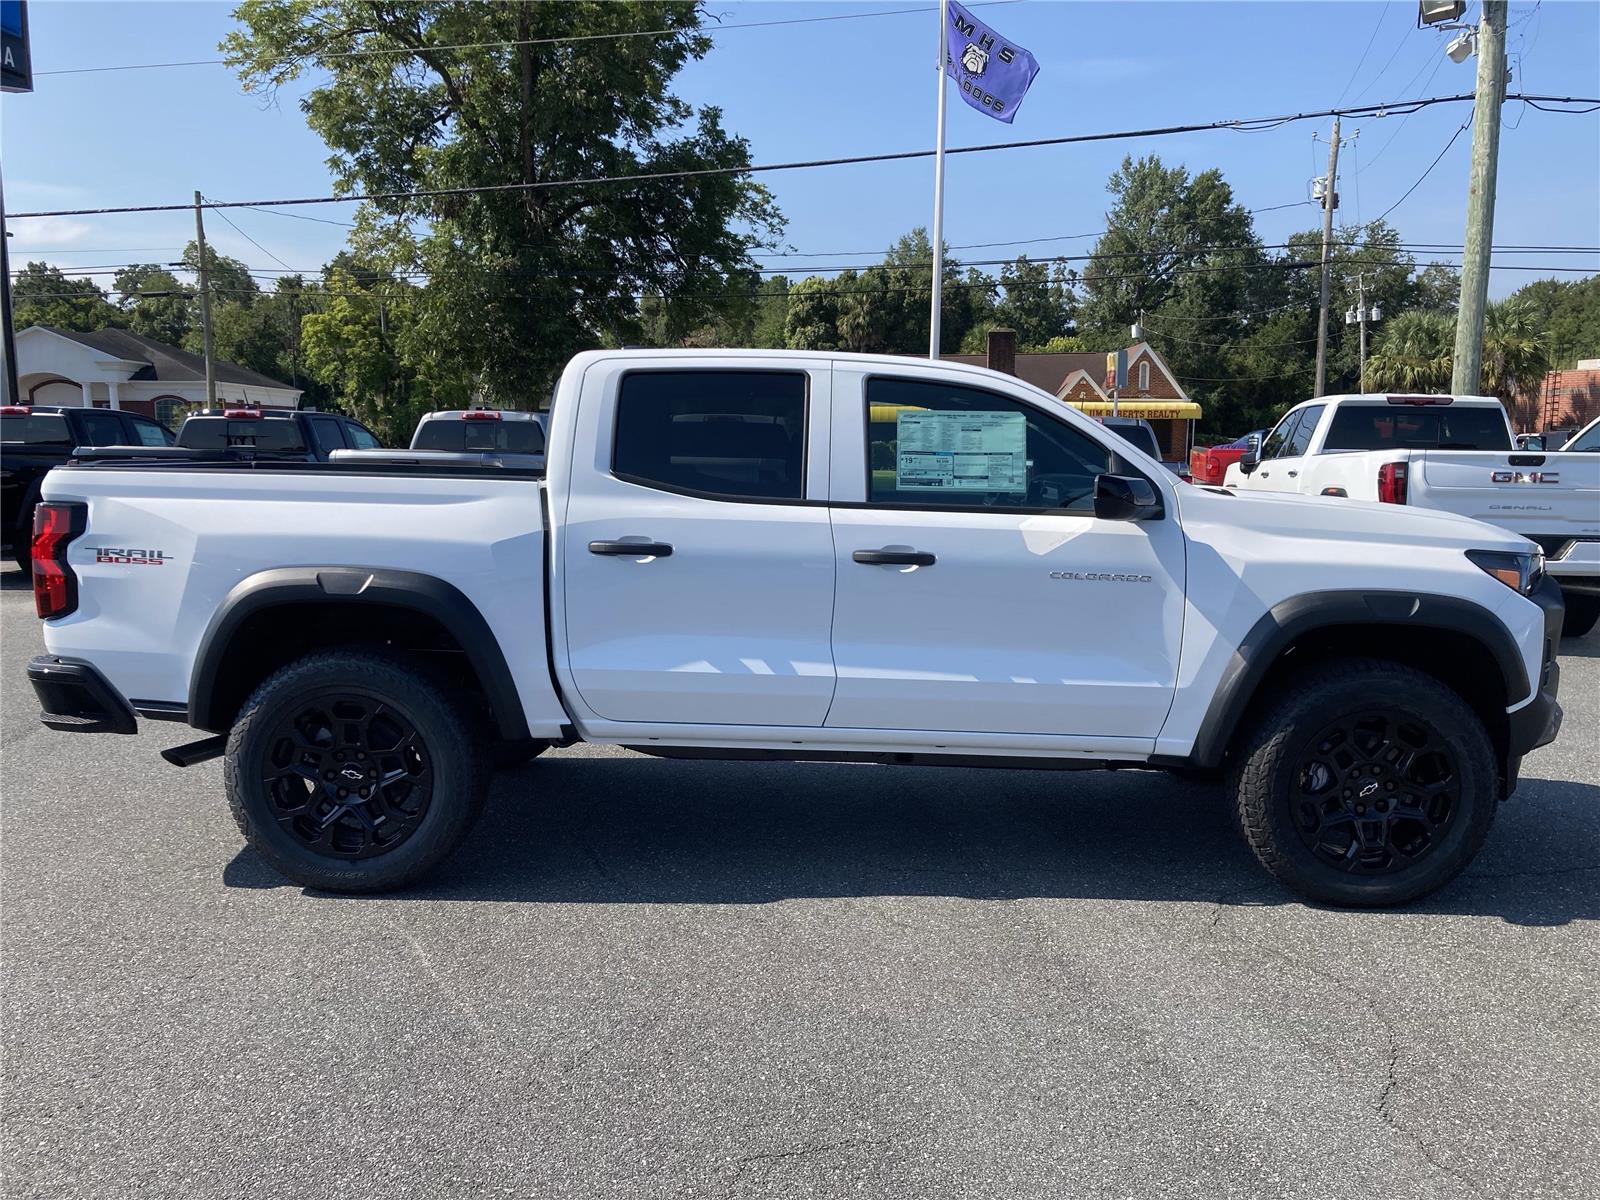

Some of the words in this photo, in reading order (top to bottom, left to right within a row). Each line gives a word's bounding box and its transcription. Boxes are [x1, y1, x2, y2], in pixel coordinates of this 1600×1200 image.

[1147, 409, 1180, 418] REALTY
[1491, 471, 1559, 484] GMC
[85, 547, 174, 559] TRAIL
[96, 556, 163, 565] BOSS
[1049, 571, 1153, 583] COLORADO
